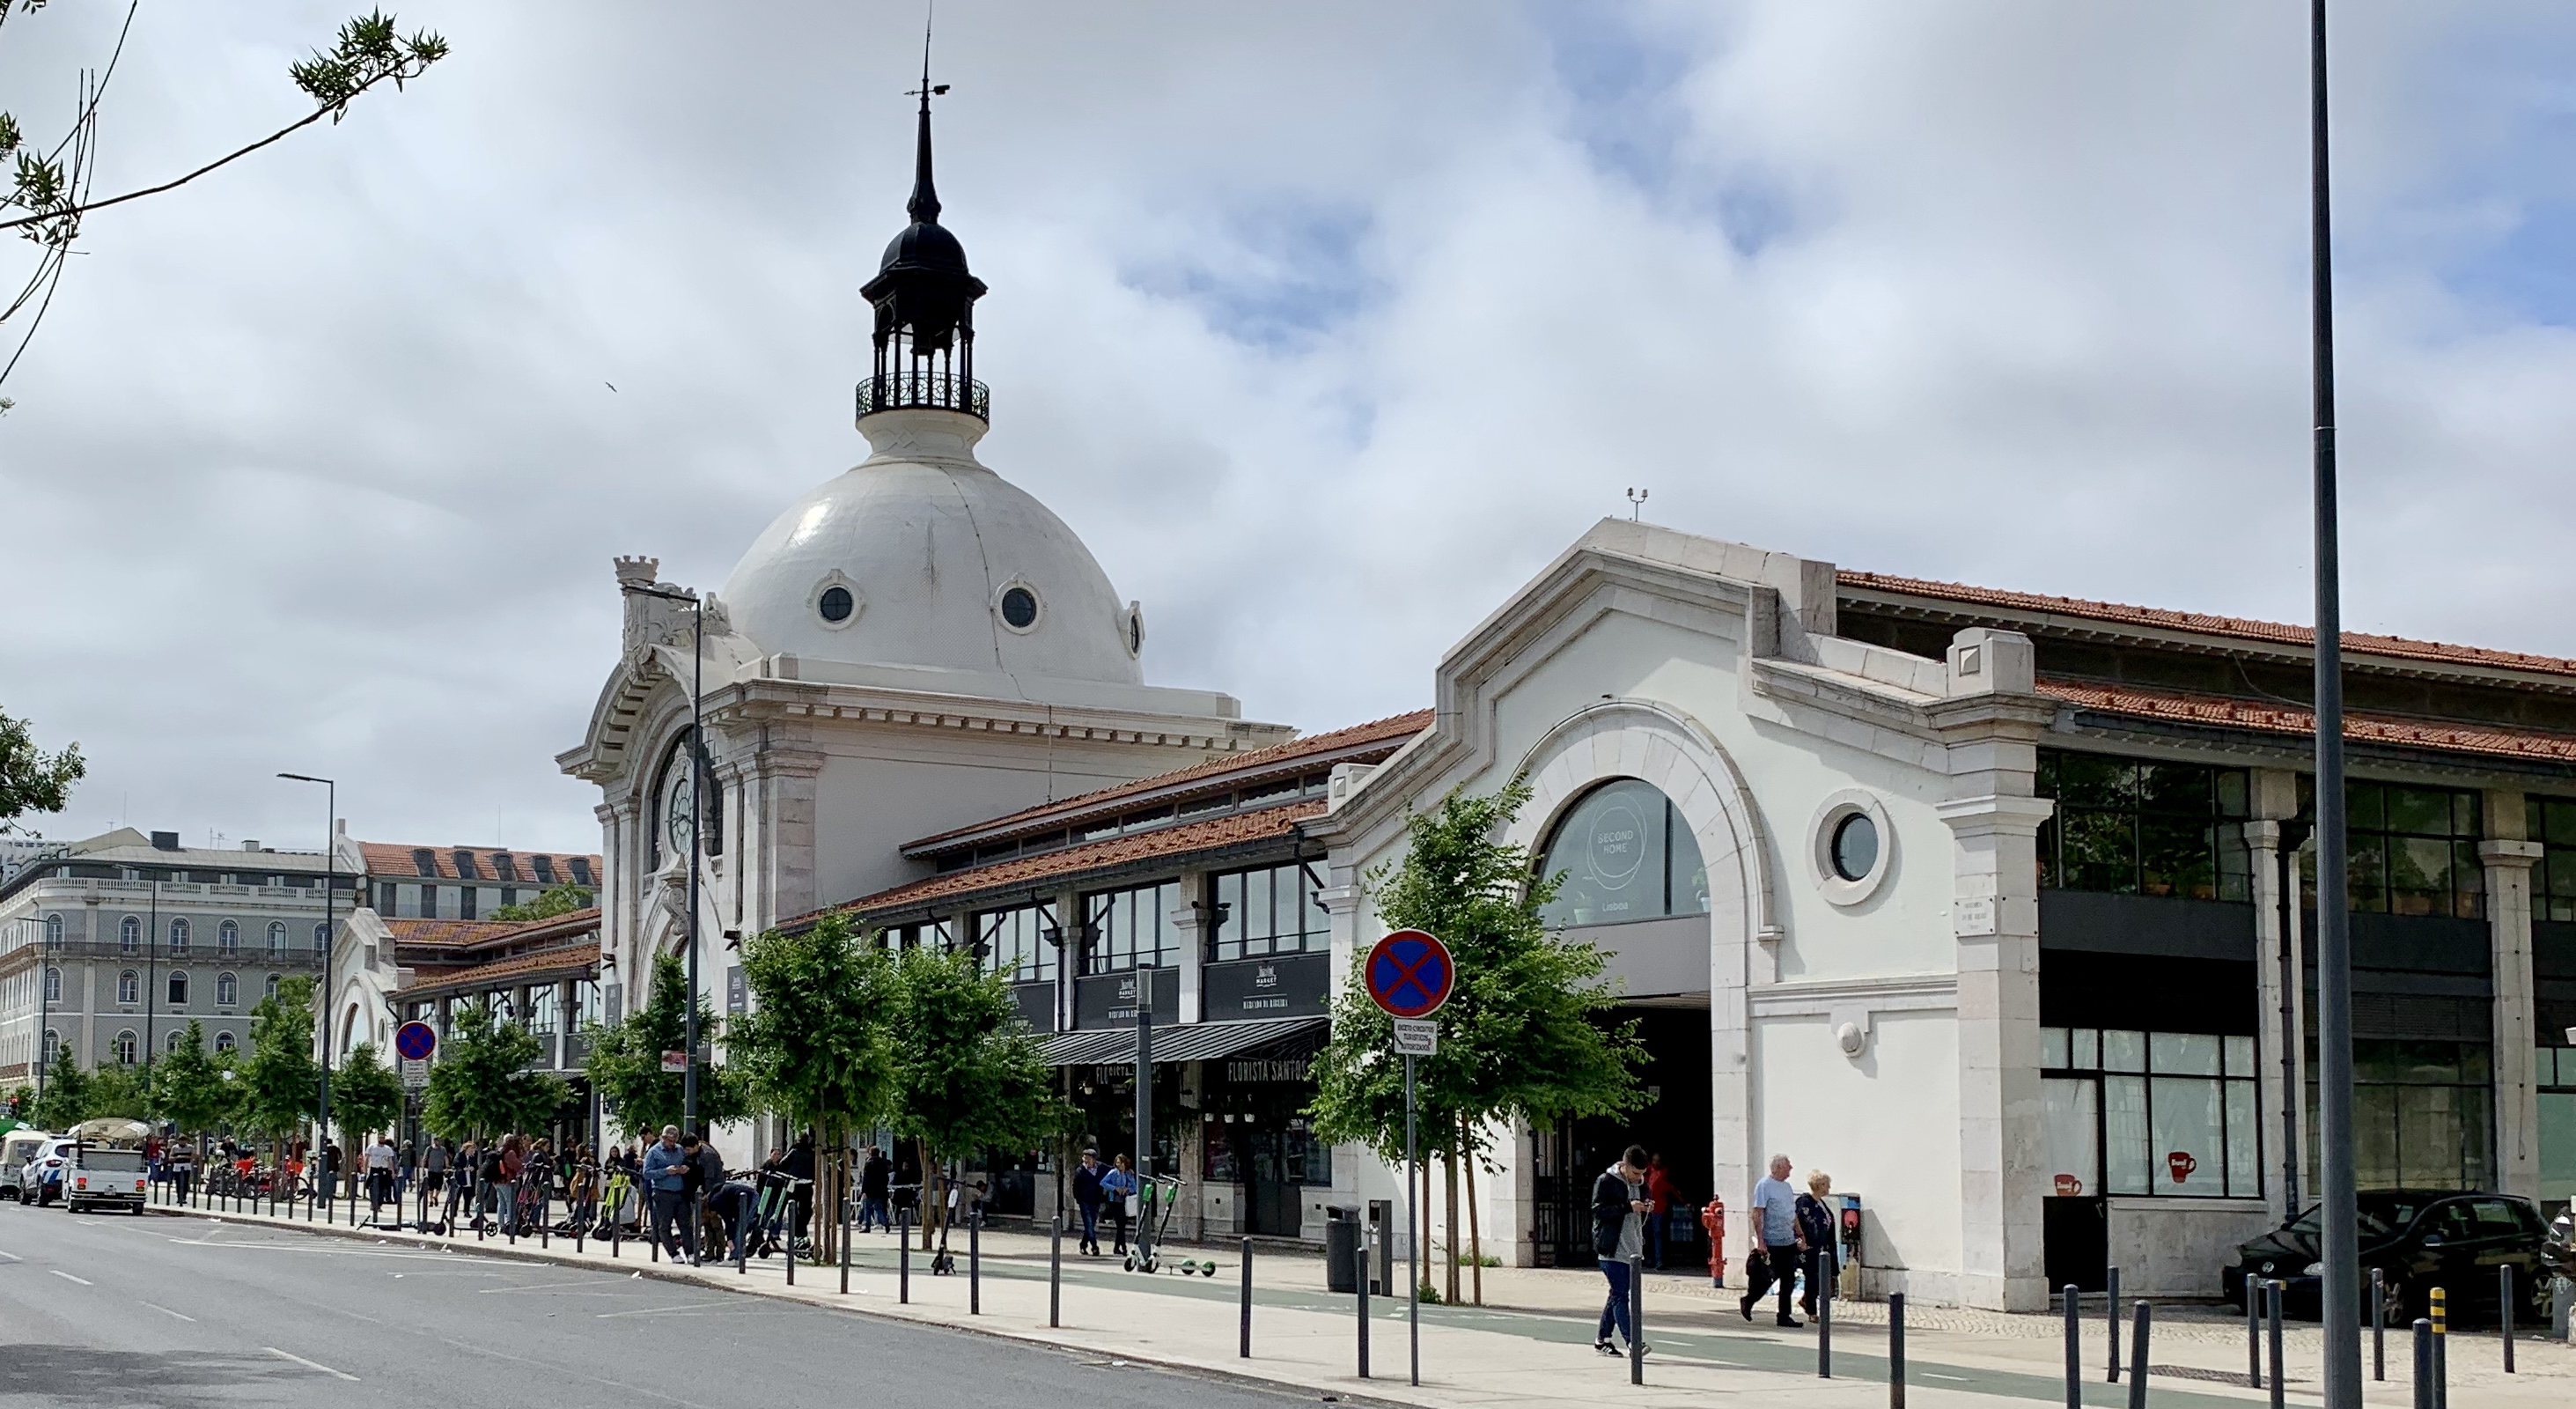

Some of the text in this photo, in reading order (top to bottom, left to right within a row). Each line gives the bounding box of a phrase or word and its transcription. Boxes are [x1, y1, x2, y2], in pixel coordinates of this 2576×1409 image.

[1598, 830, 1634, 845] SECOND
[1603, 843, 1628, 854] HOME
[1601, 901, 1629, 912] Lisboa
[1228, 1059, 1307, 1081] FLORISTA SANTOS
